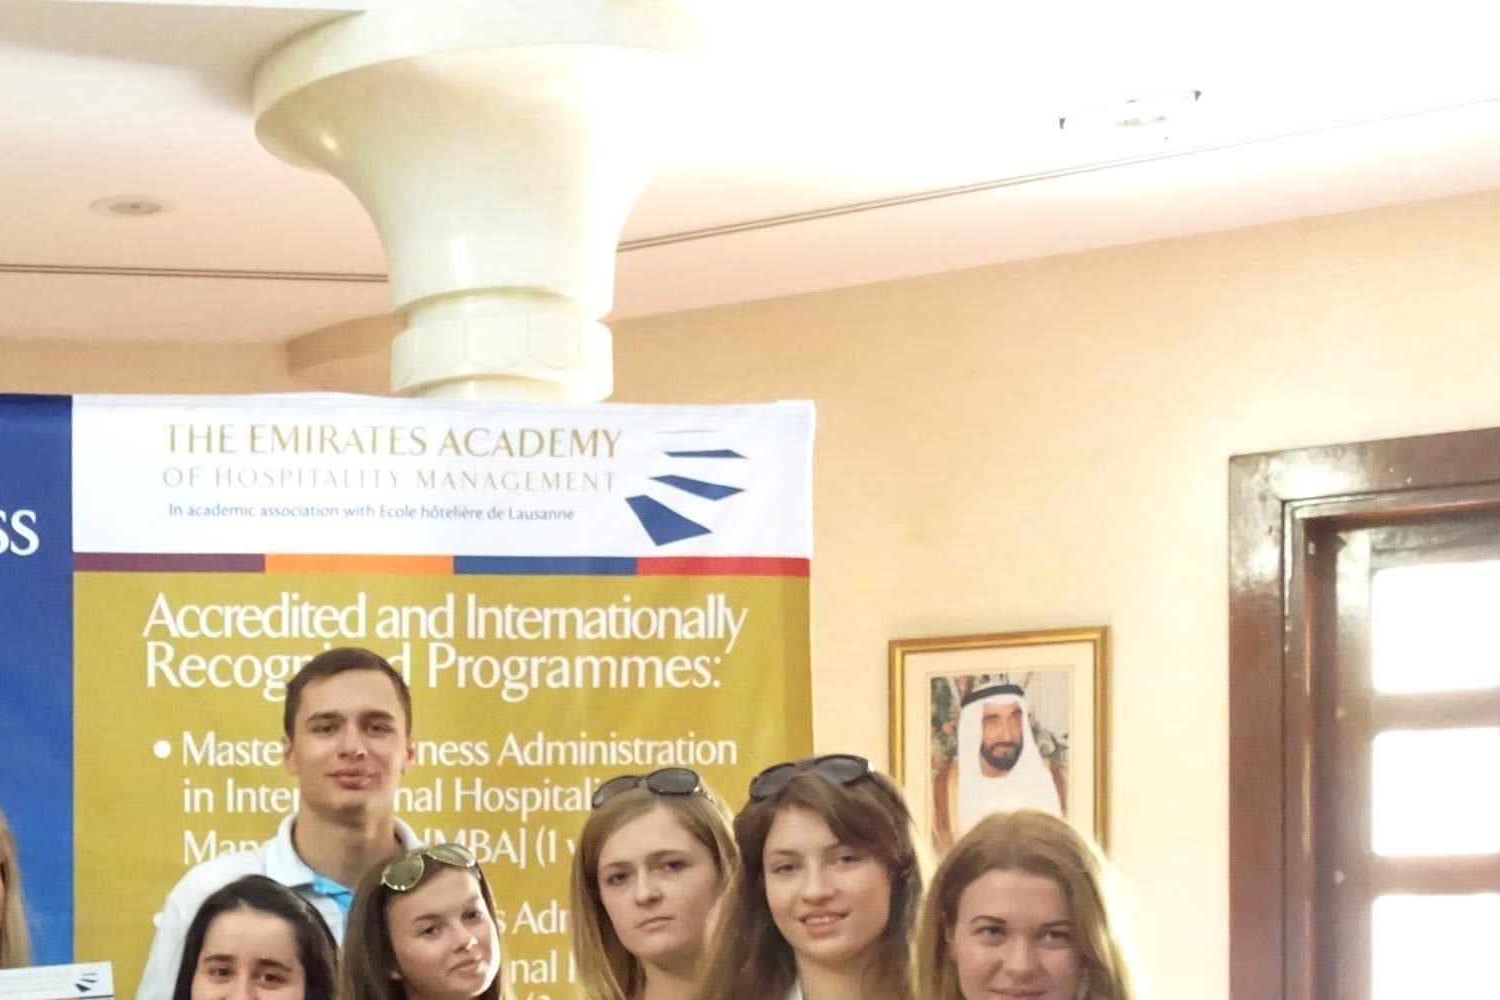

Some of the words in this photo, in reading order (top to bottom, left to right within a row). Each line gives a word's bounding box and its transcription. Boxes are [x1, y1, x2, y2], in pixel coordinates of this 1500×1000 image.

[162, 424, 237, 454] THE
[248, 425, 427, 457] EMIRATES
[437, 427, 624, 459] ACADEMY
[162, 466, 203, 489] OF
[215, 467, 401, 491] HOSPITALITY
[416, 469, 618, 494] MANAGEMENT
[169, 502, 183, 517] In
[186, 503, 256, 518] academic
[260, 503, 340, 519] association
[344, 503, 376, 519] with
[487, 505, 505, 520] de
[508, 505, 576, 521] Lausanne
[143, 592, 366, 640] Accredited
[375, 594, 456, 640] and
[467, 594, 747, 653] Internationally
[146, 641, 411, 703] Recogd
[428, 643, 722, 700] Programmes:
[181, 730, 285, 767] Maste
[498, 731, 738, 767] Administration
[183, 778, 214, 813] in
[454, 776, 601, 824] Hospital
